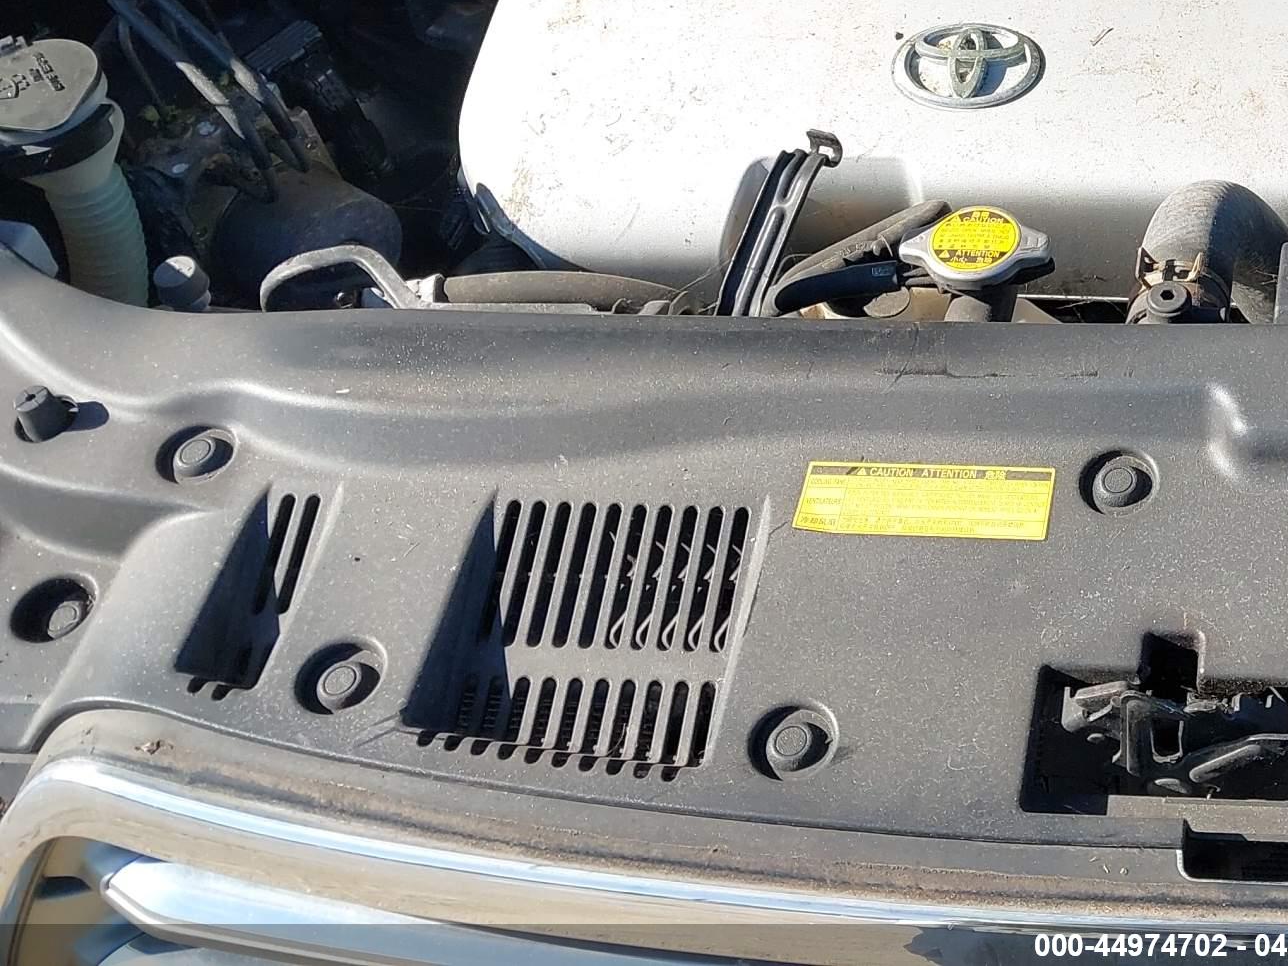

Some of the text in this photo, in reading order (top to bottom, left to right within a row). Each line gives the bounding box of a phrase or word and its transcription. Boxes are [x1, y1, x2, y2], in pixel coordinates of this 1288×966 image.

[956, 250, 1000, 258] ATTENTION
[869, 467, 914, 477] CAUTION
[921, 469, 977, 479] ATTENTION
